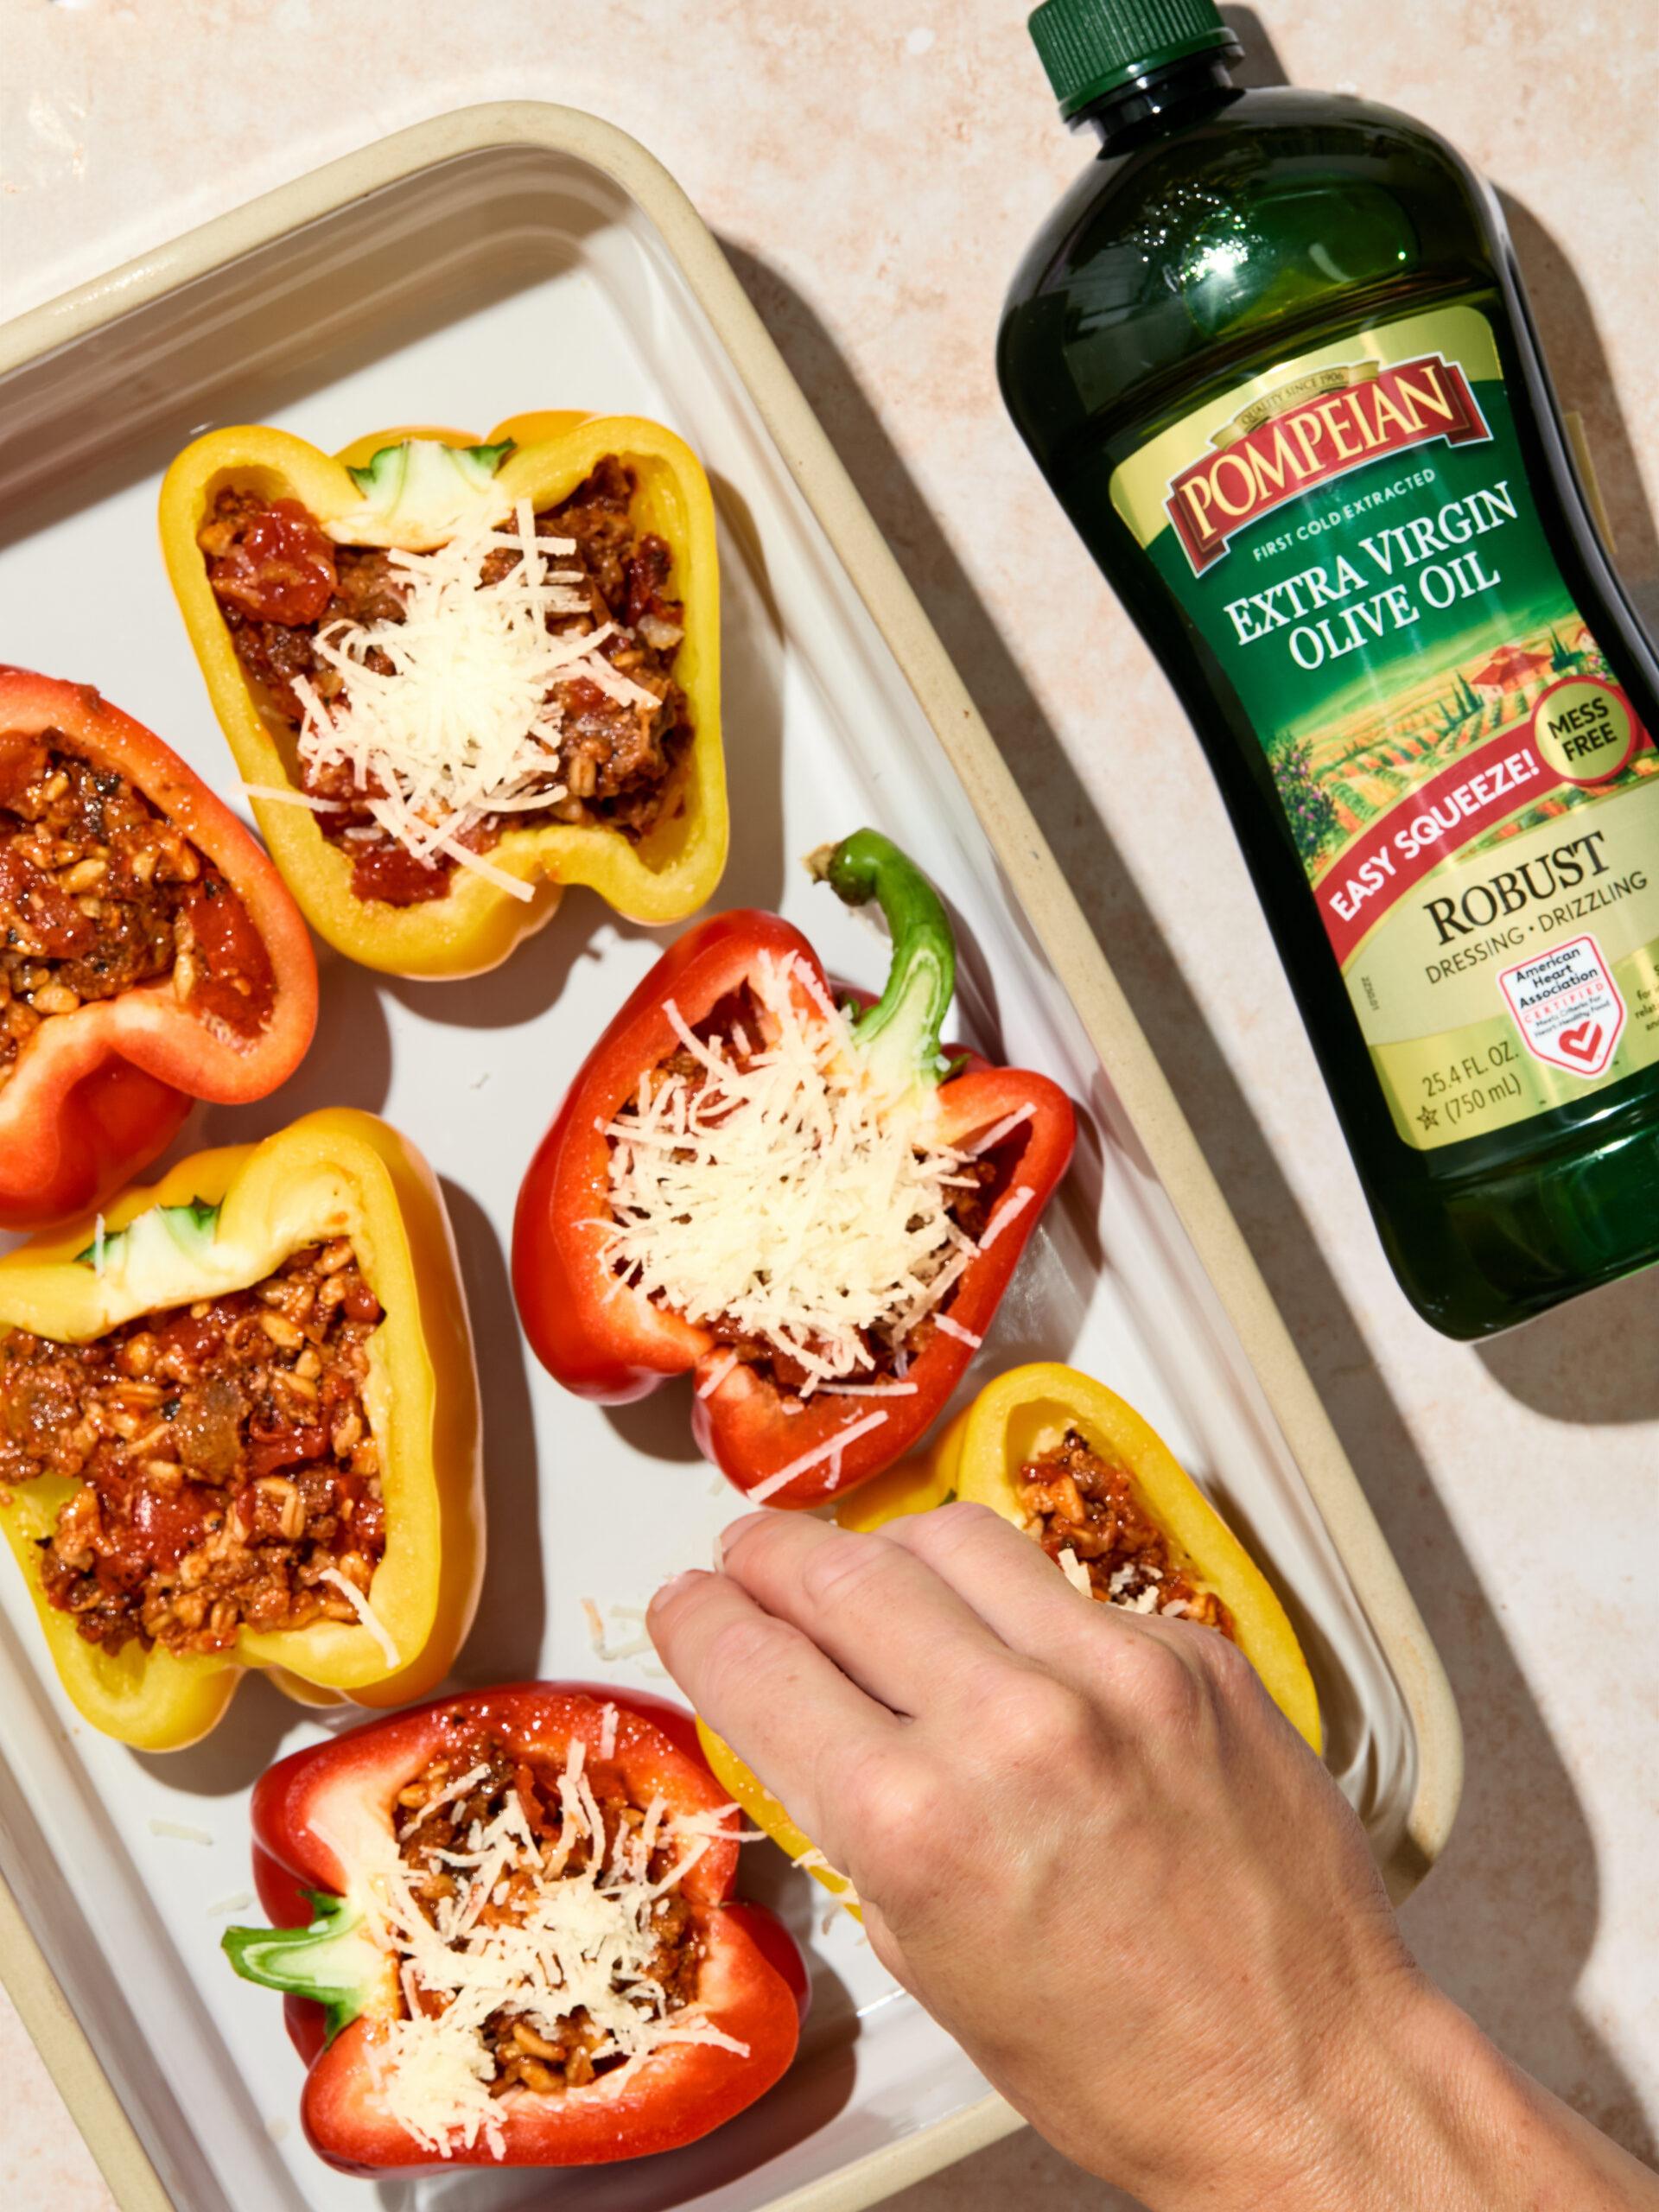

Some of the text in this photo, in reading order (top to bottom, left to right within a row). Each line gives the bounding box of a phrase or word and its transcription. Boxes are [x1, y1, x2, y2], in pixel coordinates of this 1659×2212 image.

[1241, 393, 1283, 425] QUALITY
[1286, 378, 1317, 396] SINCE
[1179, 365, 1455, 541] POMPEIAN
[1253, 467, 1436, 563] FIRST COLD EXTRACTED
[1223, 480, 1518, 647] EXTRA VIRGIN
[1288, 551, 1501, 671] OLIVE OIL
[1548, 697, 1609, 740] MESS
[1561, 722, 1618, 761] FREE
[1328, 748, 1541, 922] EASY SQUEEZE!
[1422, 830, 1610, 945] ROBUST
[1425, 870, 1648, 984] DRESSING DRIZZLING
[1516, 948, 1580, 982] American
[1519, 968, 1599, 1009] Association
[1532, 964, 1573, 988] Heart
[1524, 982, 1604, 1023] CERTIFIED
[1421, 1039, 1520, 1098] 25.4 FL. OZ.
[1444, 1072, 1523, 1125] (750 mL)
